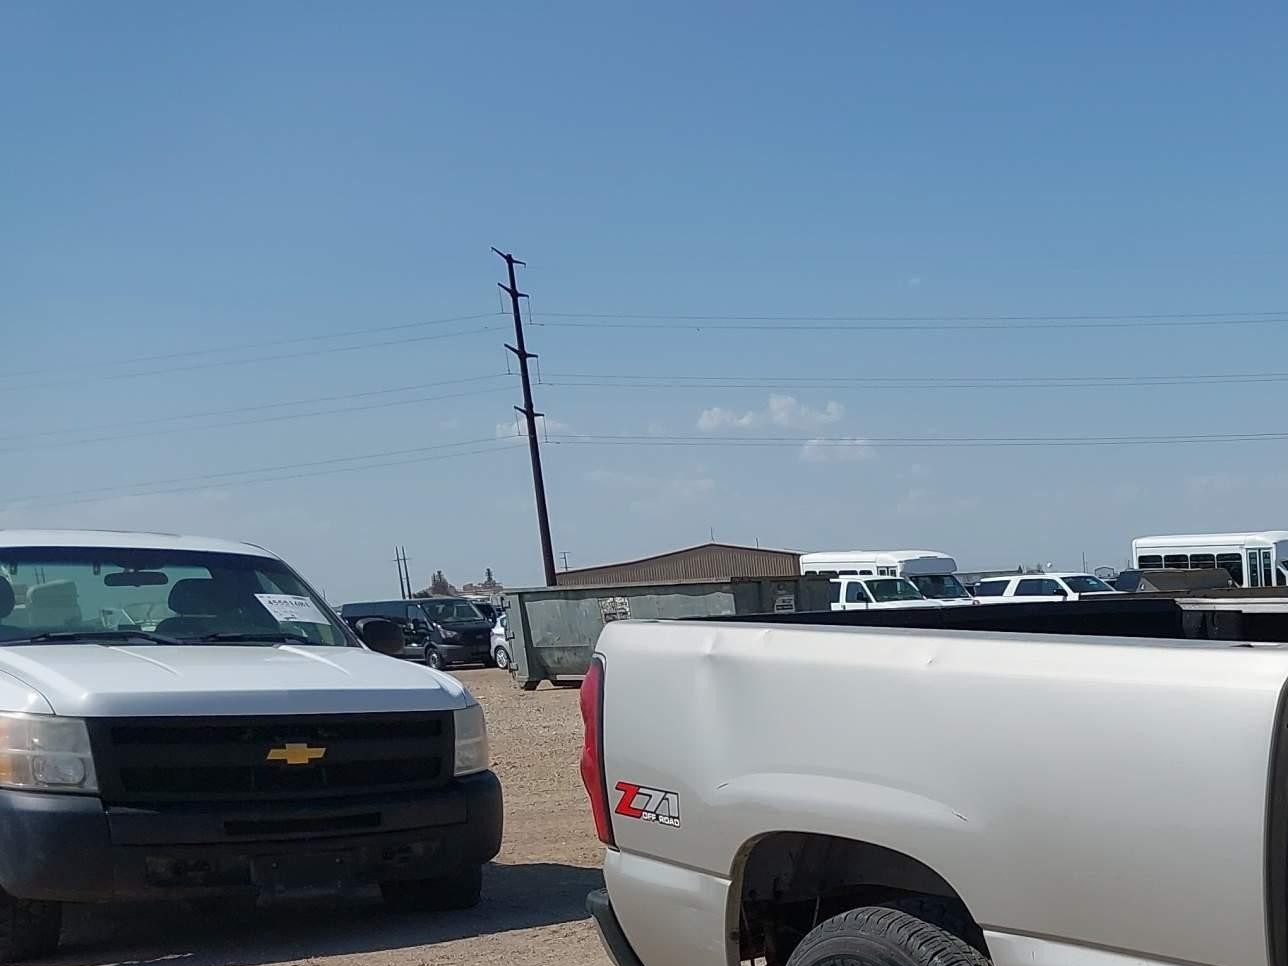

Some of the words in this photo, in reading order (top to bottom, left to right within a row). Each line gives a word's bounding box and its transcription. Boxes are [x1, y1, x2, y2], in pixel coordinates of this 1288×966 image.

[615, 781, 680, 819] Z71
[641, 811, 657, 821] OFF
[658, 815, 680, 827] ROAD
